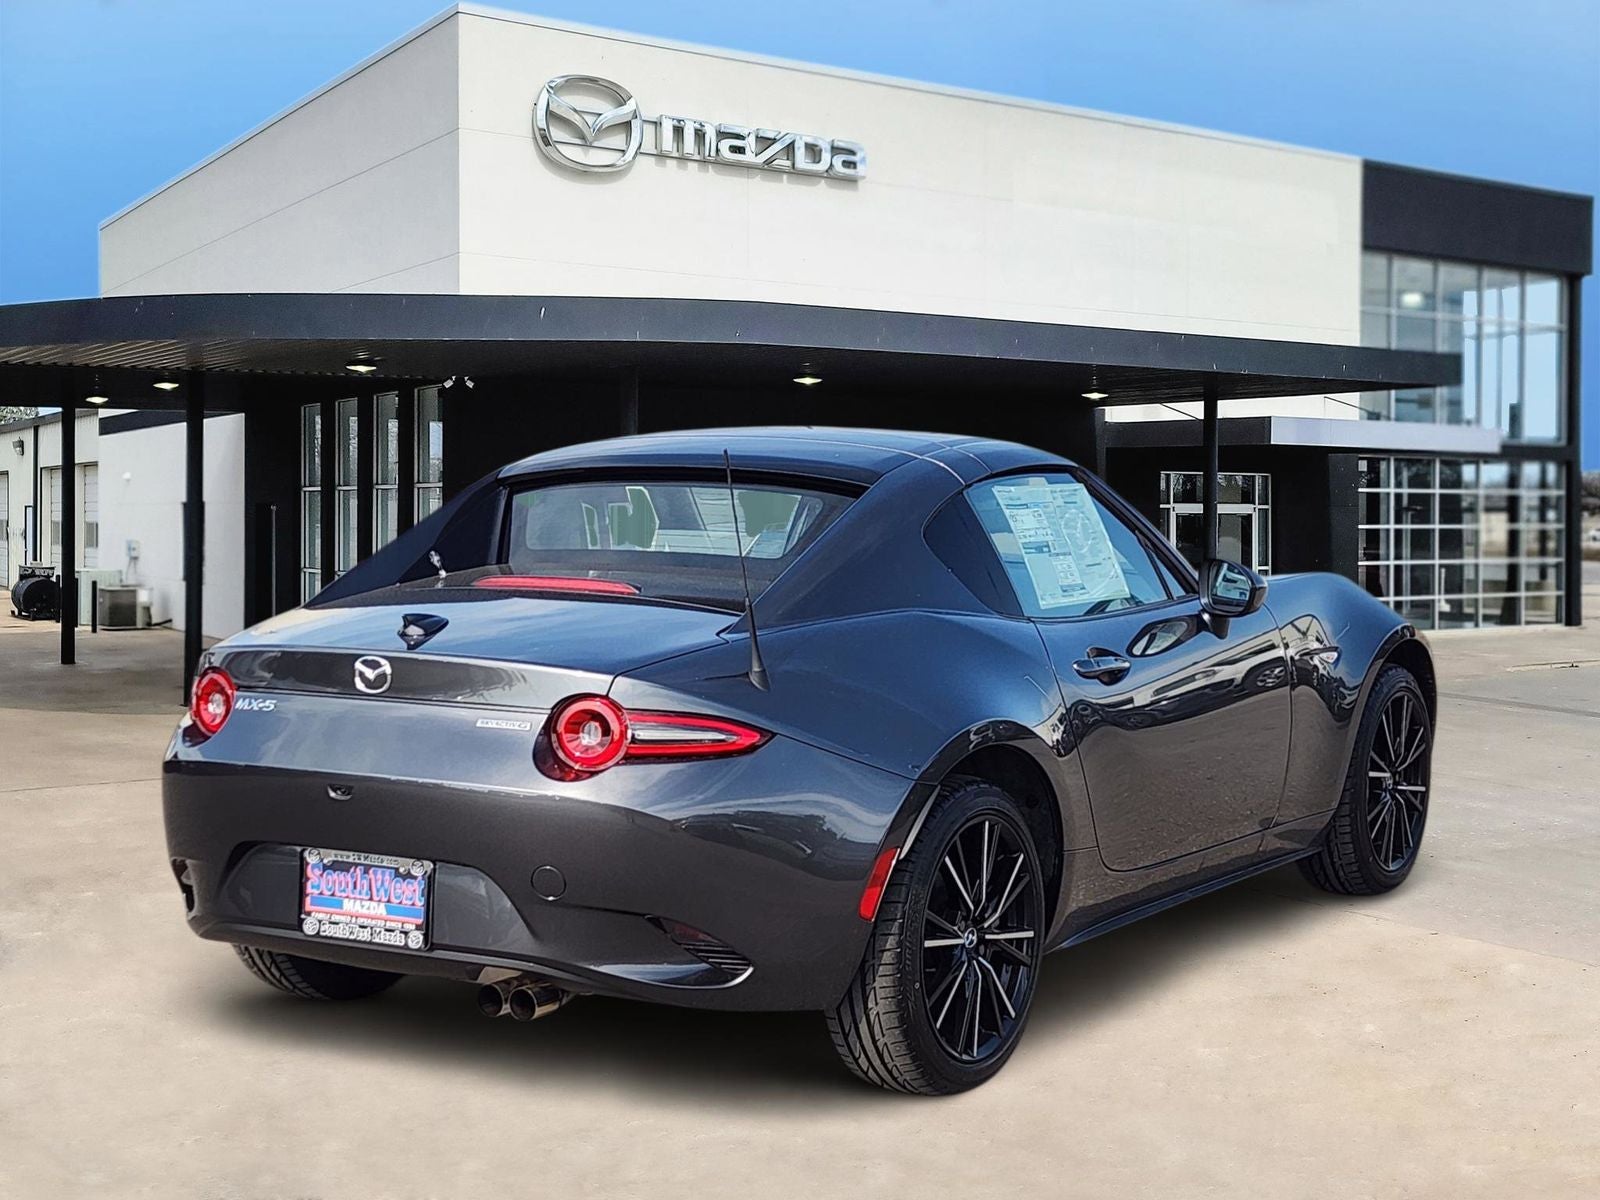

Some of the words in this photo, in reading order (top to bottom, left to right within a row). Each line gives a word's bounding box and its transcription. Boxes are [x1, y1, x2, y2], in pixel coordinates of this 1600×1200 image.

[235, 697, 277, 711] MX-5
[342, 898, 386, 915] MAZDA
[372, 927, 405, 945] Mazda
